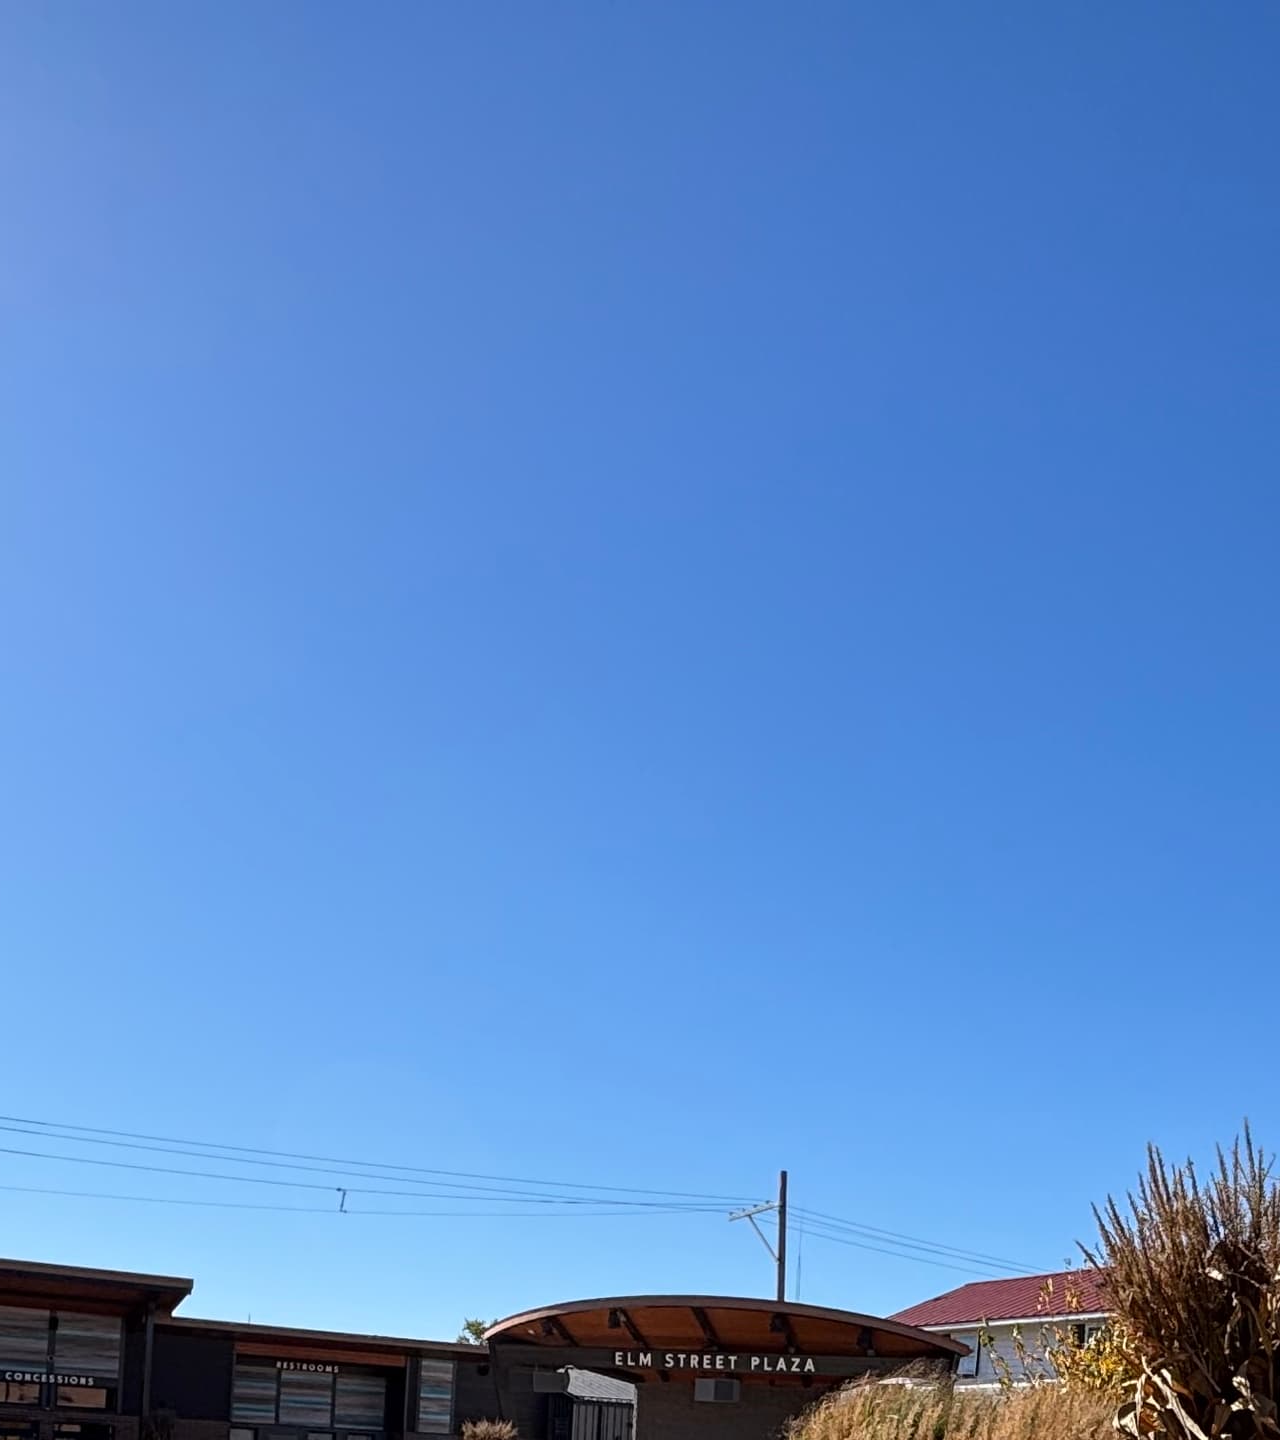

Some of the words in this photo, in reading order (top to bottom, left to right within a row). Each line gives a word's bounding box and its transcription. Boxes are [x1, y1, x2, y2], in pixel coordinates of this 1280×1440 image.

[276, 1361, 339, 1373] RESTROOMS
[614, 1352, 652, 1367] ELM
[664, 1354, 738, 1370] STREET
[750, 1356, 816, 1372] PLAZA
[5, 1372, 95, 1386] CONCESSIONS
